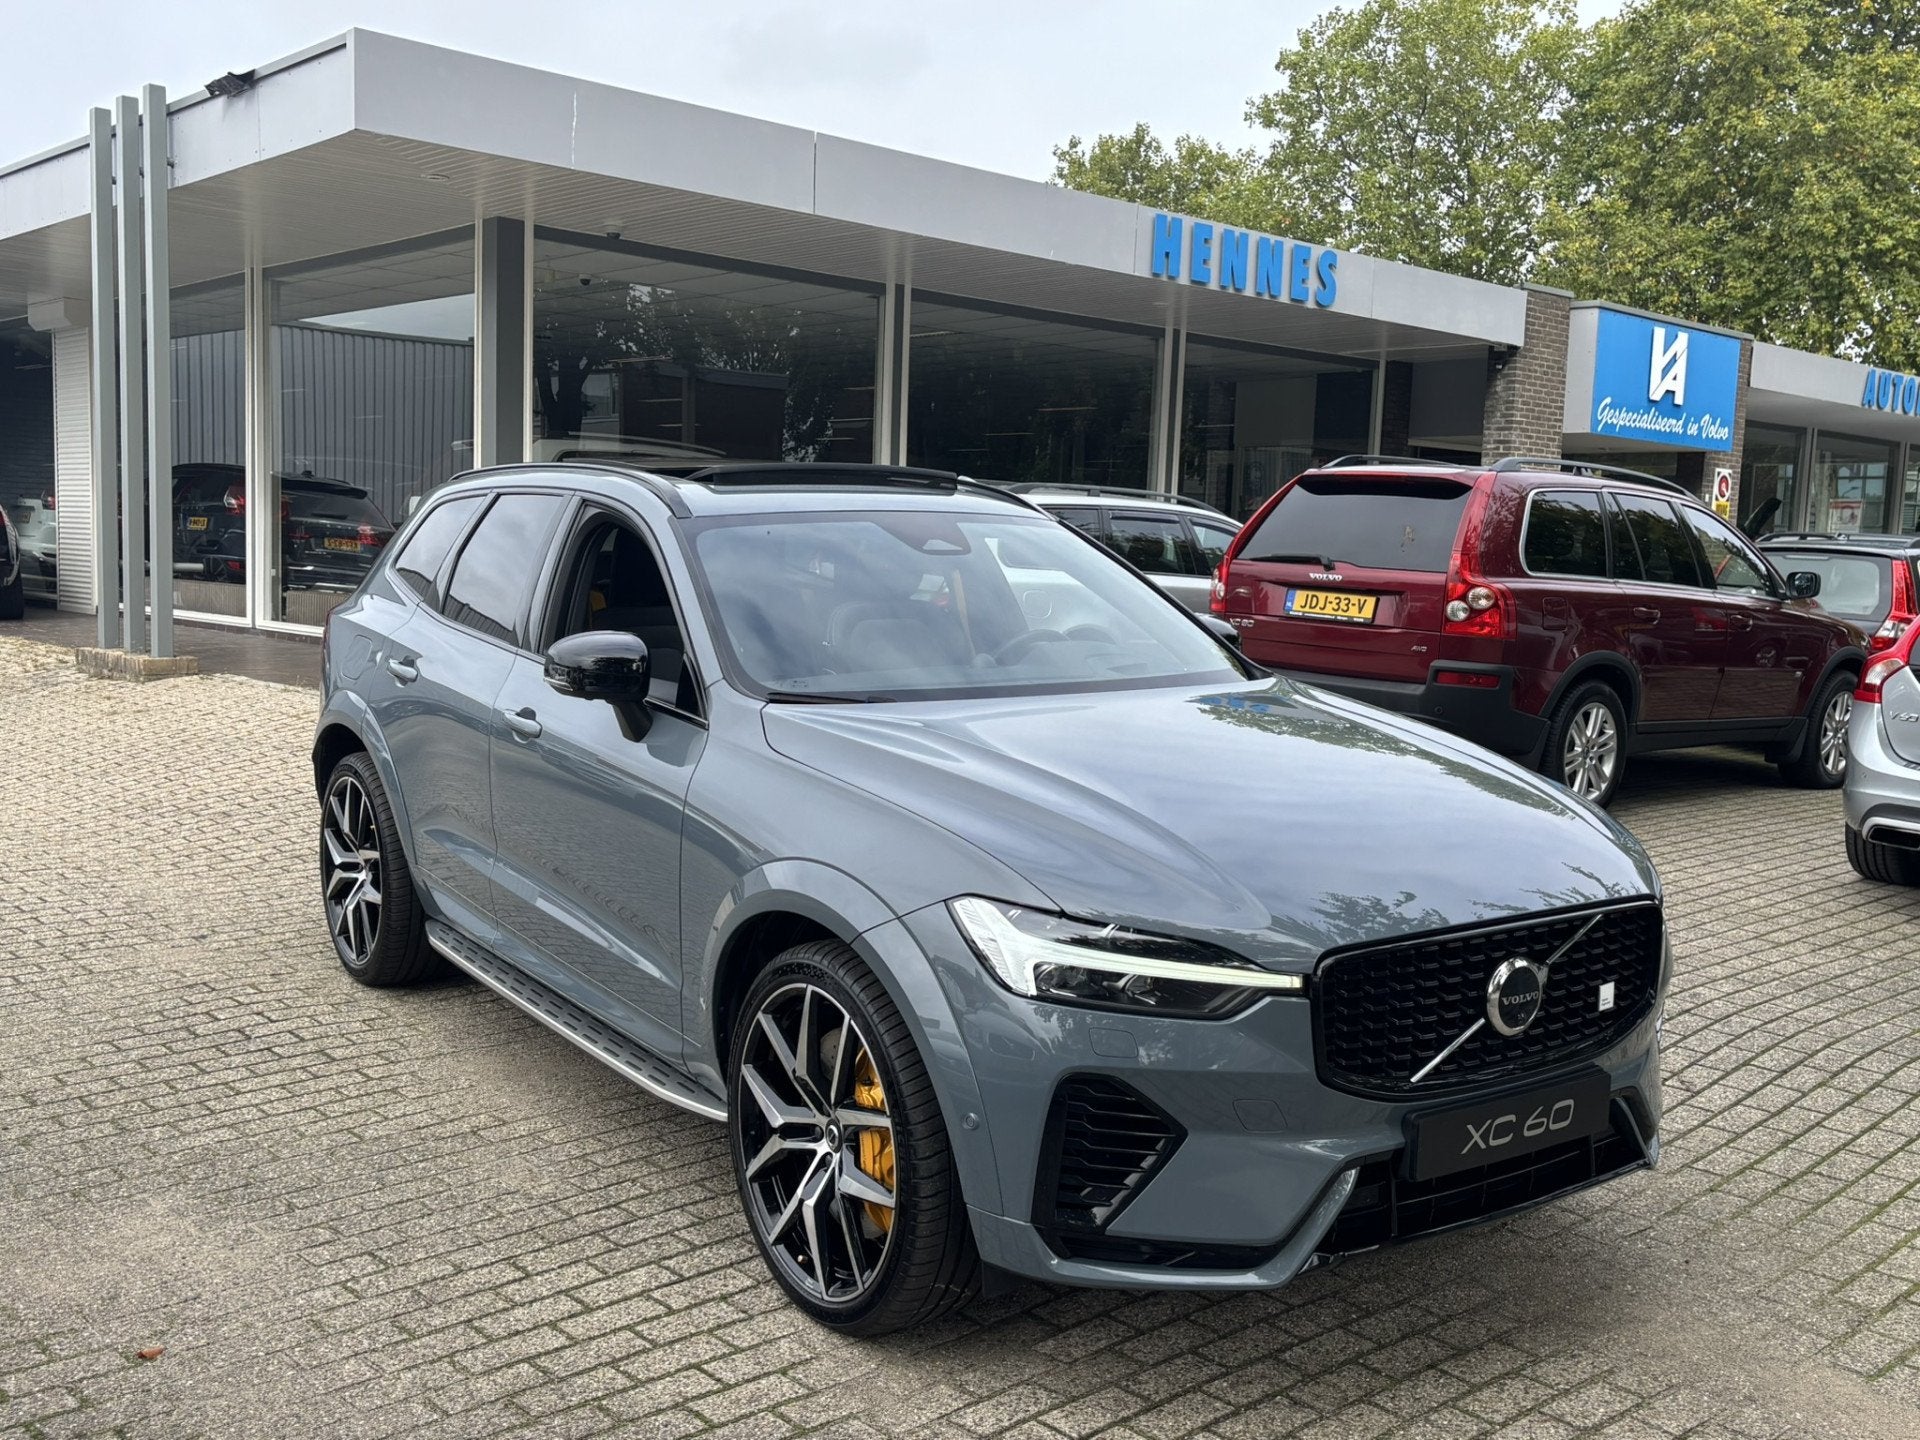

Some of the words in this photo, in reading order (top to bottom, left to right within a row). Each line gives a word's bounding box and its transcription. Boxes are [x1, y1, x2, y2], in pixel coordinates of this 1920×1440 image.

[1152, 213, 1338, 308] HENNES
[1597, 396, 1686, 434] Gespecialiseerd
[1687, 415, 1699, 437] in
[1701, 413, 1729, 441] Volvo
[1309, 572, 1343, 581] VOLVO
[1300, 594, 1367, 614] JDJ-33-V
[1501, 990, 1539, 1006] VOLVO
[1460, 1114, 1517, 1155] XC
[1523, 1098, 1575, 1137] 60
